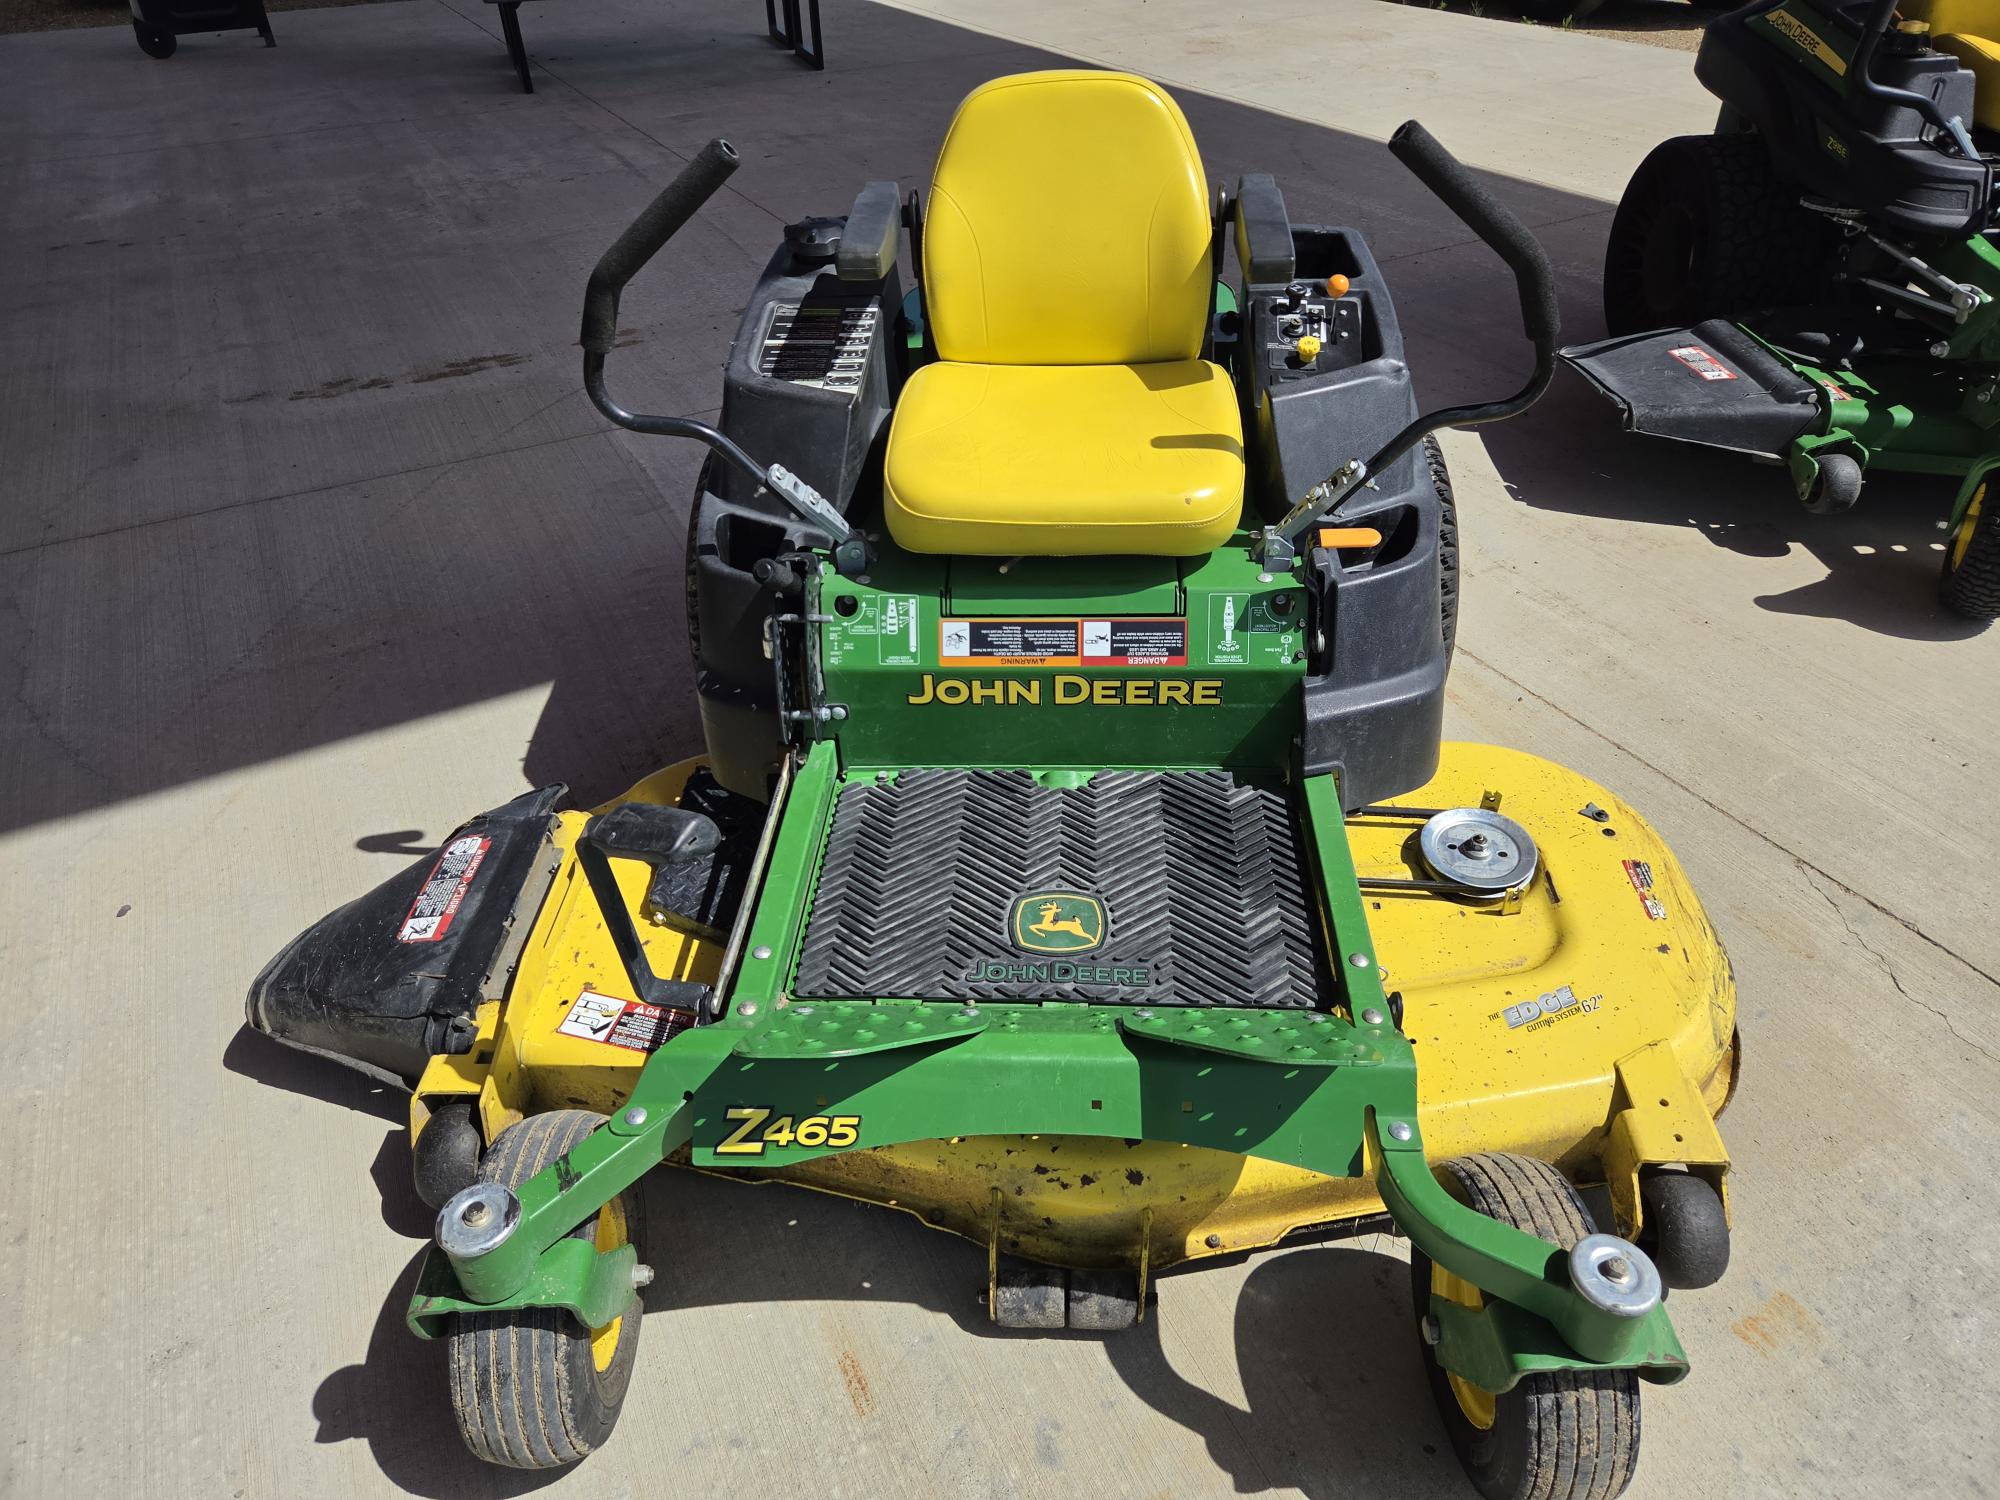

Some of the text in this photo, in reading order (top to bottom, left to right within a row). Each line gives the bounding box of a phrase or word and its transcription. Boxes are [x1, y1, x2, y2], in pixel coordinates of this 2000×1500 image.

[1770, 11, 1820, 53] JOHN DEERE
[1127, 657, 1160, 665] DANGER
[906, 672, 1225, 706] JOHN DEERE
[966, 959, 1152, 986] JOHN DEERE
[645, 1006, 688, 1023] DANGER
[1487, 984, 1579, 1030] THE EDGE
[1526, 1016, 1556, 1033] CUTTING
[1555, 1005, 1582, 1023] SYSTEM
[714, 1105, 863, 1156] Z465
